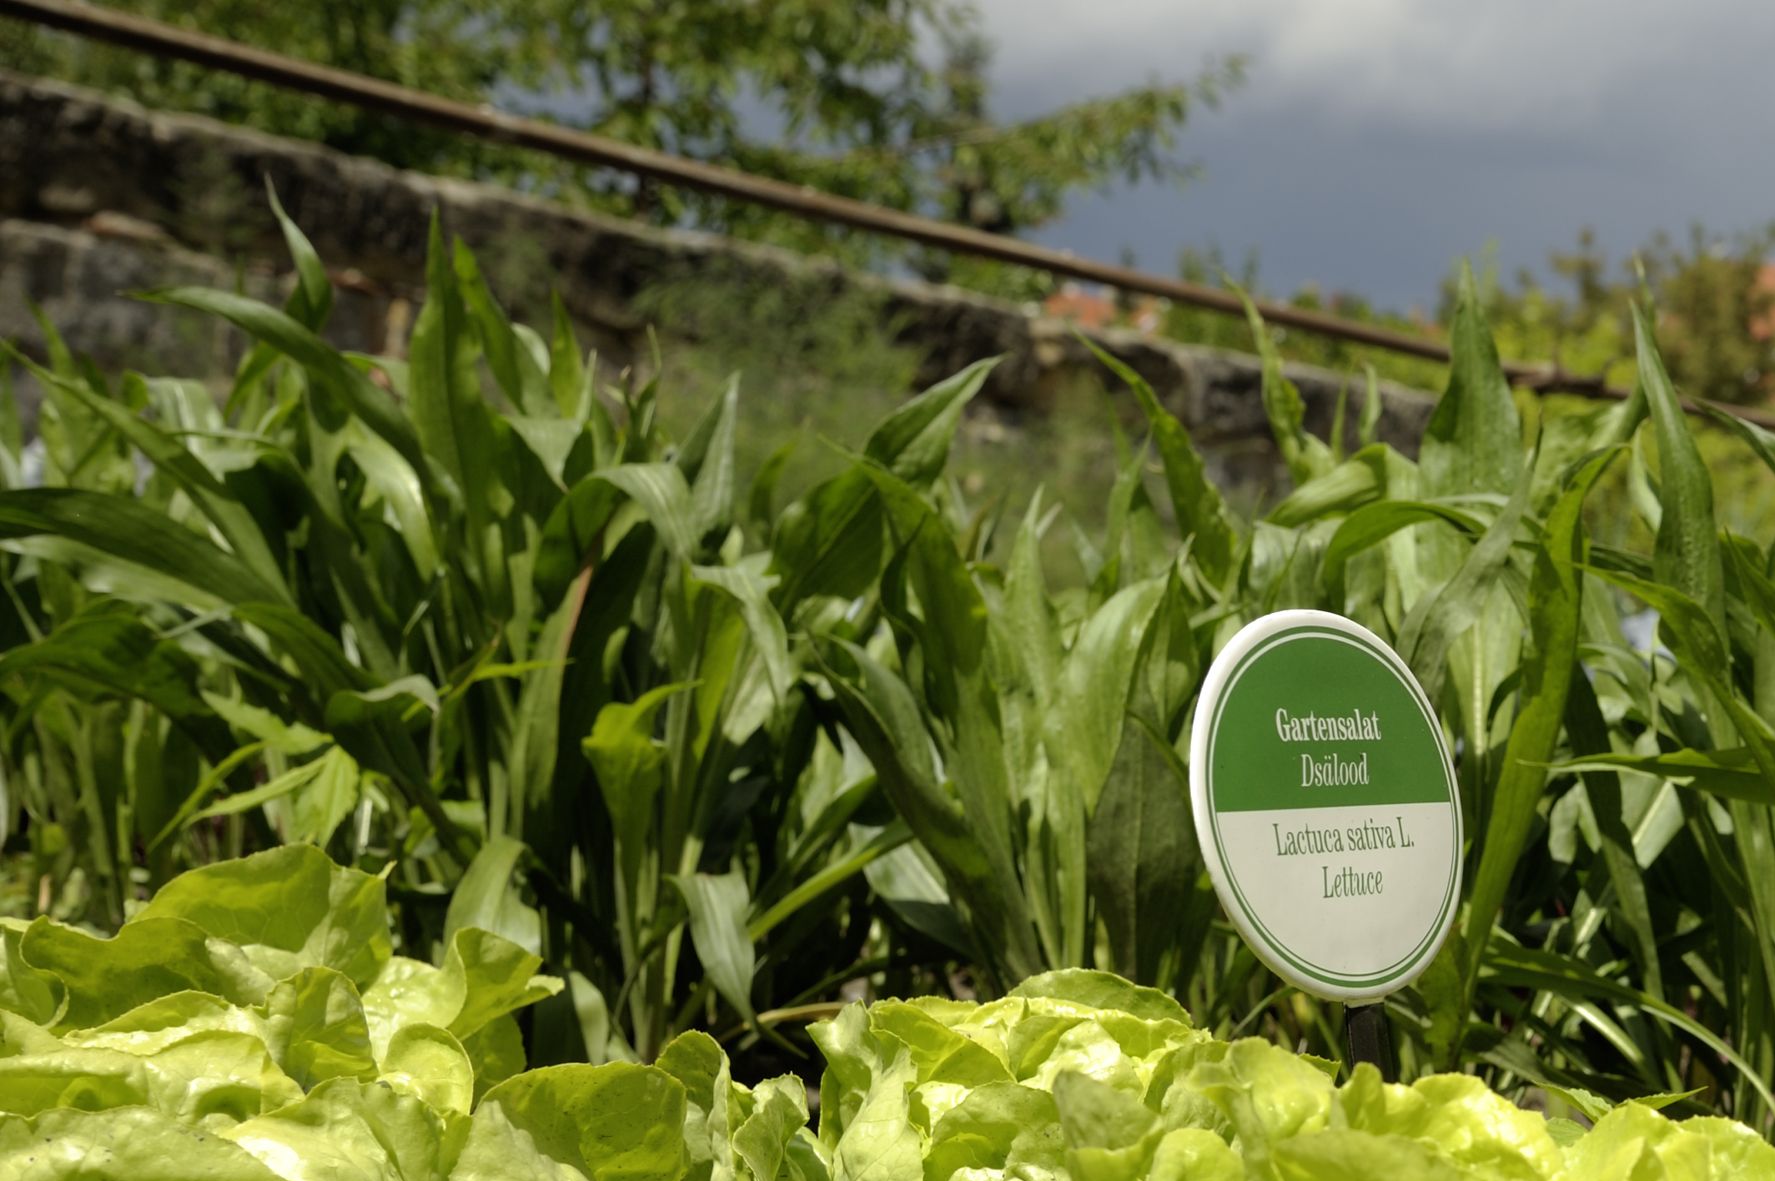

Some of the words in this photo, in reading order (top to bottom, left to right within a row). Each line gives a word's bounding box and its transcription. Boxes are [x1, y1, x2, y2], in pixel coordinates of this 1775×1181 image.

[1275, 707, 1382, 742] Gartensalat
[1300, 753, 1370, 787] Dsälood
[1272, 822, 1344, 857] Lactuca
[1346, 818, 1396, 852] sativa
[1396, 816, 1415, 848] L.
[1322, 866, 1384, 899] Lettuce
